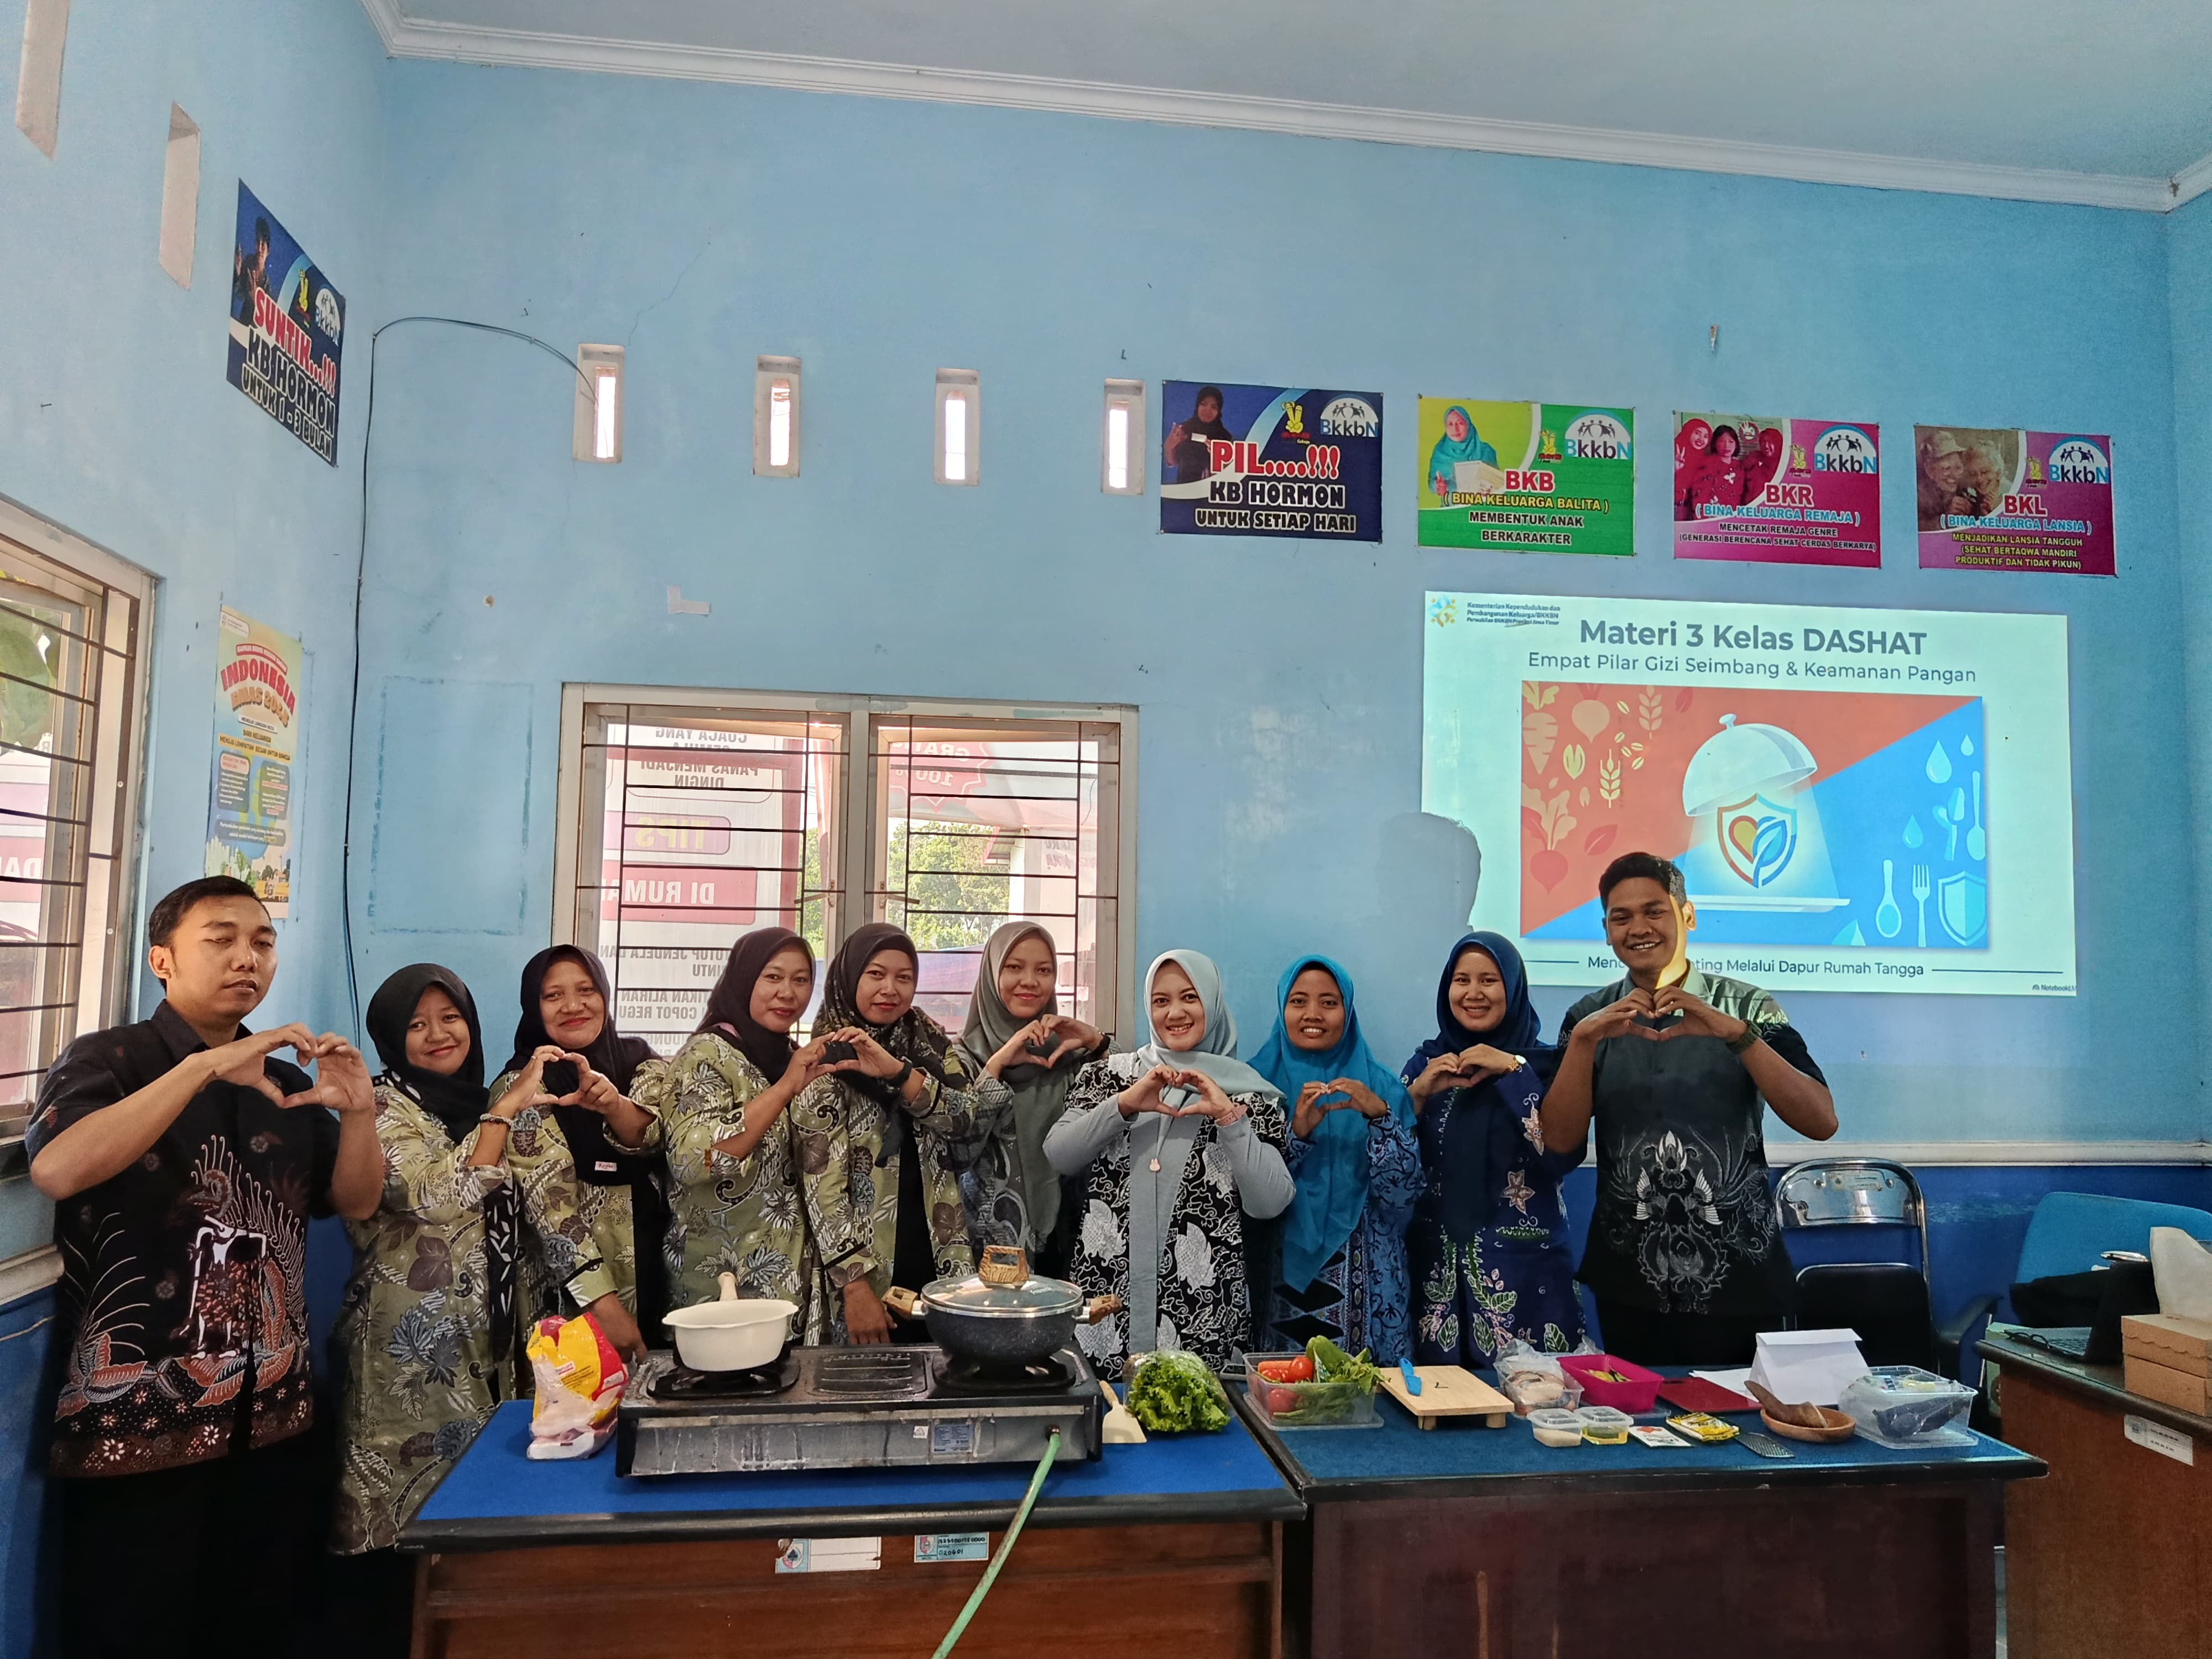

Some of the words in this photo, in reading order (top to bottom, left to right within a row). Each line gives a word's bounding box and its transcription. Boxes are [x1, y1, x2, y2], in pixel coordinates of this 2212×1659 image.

[247, 325, 272, 380] KB
[275, 351, 336, 438] HORMON
[242, 363, 277, 416] UNTUK
[294, 408, 301, 435] 3
[302, 416, 332, 461] BULAN
[1505, 469, 1556, 492] BKB
[1208, 481, 1243, 504] KB
[1248, 482, 1345, 509] HORMON
[1452, 492, 1483, 505] BINA
[1486, 493, 1554, 509] KELUARGA
[1556, 497, 1601, 511] BALITA
[1765, 482, 1814, 507] BKR
[1703, 504, 1734, 517] BINA
[1736, 505, 1803, 521] KELUARGA
[1804, 509, 1853, 524] REMAJA
[2003, 494, 2048, 517] BKL
[1196, 509, 1251, 529] UNTUK
[1253, 510, 1311, 530] SETIAP
[1313, 514, 1357, 533] HARI
[1469, 511, 1547, 526] MEMBENTUK
[1549, 514, 1584, 528] ANAK
[1948, 515, 1976, 528] BINA
[1979, 517, 2041, 531] KELUARGA
[2043, 519, 2085, 533] LANSIA
[1481, 529, 1571, 545] BERKARAKTER
[1719, 523, 1768, 534] MENCETAK
[1770, 525, 1806, 536] REMAJA
[1808, 527, 1838, 538] GENRE
[1952, 533, 2008, 544] MENJADIKAN
[2010, 535, 2041, 545] LANSIA
[2043, 536, 2083, 546] TANGGUH
[1679, 533, 1722, 543] (GENERASI
[1724, 535, 1772, 545] BERENCANA
[1773, 538, 1798, 547] SEHAT
[1801, 539, 1831, 549] CERDAS
[1833, 541, 1876, 552] BERKARYA)
[1961, 545, 1992, 555] (SEHAT
[1994, 546, 2040, 556] BERTAQWA
[2042, 548, 2077, 557] MANDIRI
[1955, 556, 2003, 566] PRODUKTIF
[2005, 557, 2023, 566] DAN
[2025, 559, 2051, 567] TIDAK
[2052, 560, 2081, 570] PIKUN)
[1580, 620, 1677, 646] Materi
[1686, 624, 1703, 648] 3
[1714, 624, 1794, 651] Kelas
[1803, 628, 1927, 655] DASHAT
[1529, 652, 1591, 670] Empat
[1598, 654, 1639, 671] Pilar
[1645, 655, 1679, 672] Gizi
[1685, 657, 1780, 679] Seimbang
[1786, 661, 1798, 676] &
[1805, 662, 1901, 680] Keamanan
[1908, 665, 1976, 685] Pangan
[221, 659, 295, 716] INDONESIA
[1727, 958, 1774, 972] Melalui
[1779, 961, 1820, 975] Dapur
[1824, 961, 1871, 975] Rumah
[1874, 962, 1924, 978] Tangga
